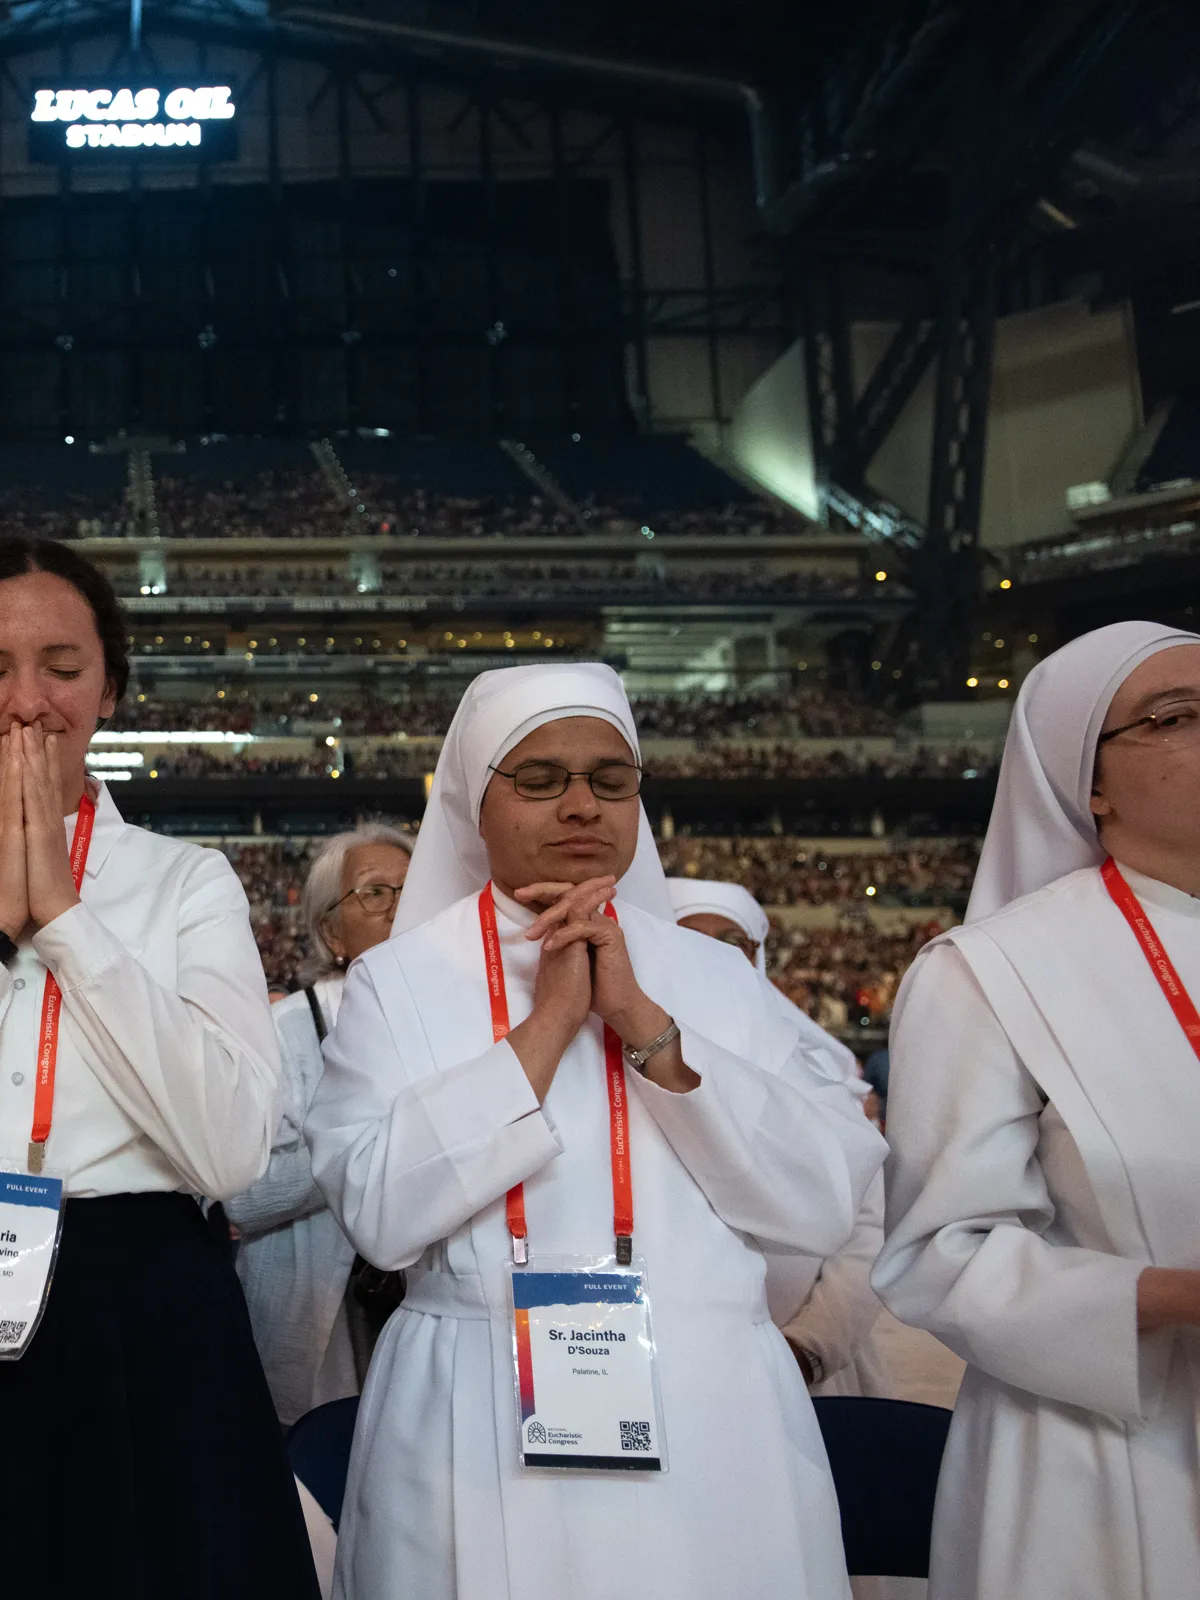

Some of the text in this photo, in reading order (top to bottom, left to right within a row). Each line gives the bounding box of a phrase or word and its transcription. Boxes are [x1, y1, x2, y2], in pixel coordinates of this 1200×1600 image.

[31, 86, 235, 121] LUCAS OIL
[66, 123, 201, 147] STADIUM
[71, 836, 86, 874] Eucharistic
[486, 929, 497, 963] Eucharistic
[1134, 918, 1181, 996] Eucharistic Congress
[490, 965, 501, 997] Congress
[44, 994, 57, 1041] Eucharistic
[41, 1043, 53, 1085] Congress
[611, 1071, 622, 1108] Congress
[614, 1109, 625, 1156] Eucharistic
[6, 1183, 49, 1195] FULL EVENT
[2, 1269, 14, 1278] MD
[548, 1329, 626, 1342] Sr. Jacintha
[567, 1345, 610, 1356] D'Souza
[572, 1368, 609, 1376] Palatine, IL
[548, 1438, 578, 1446] Congress
